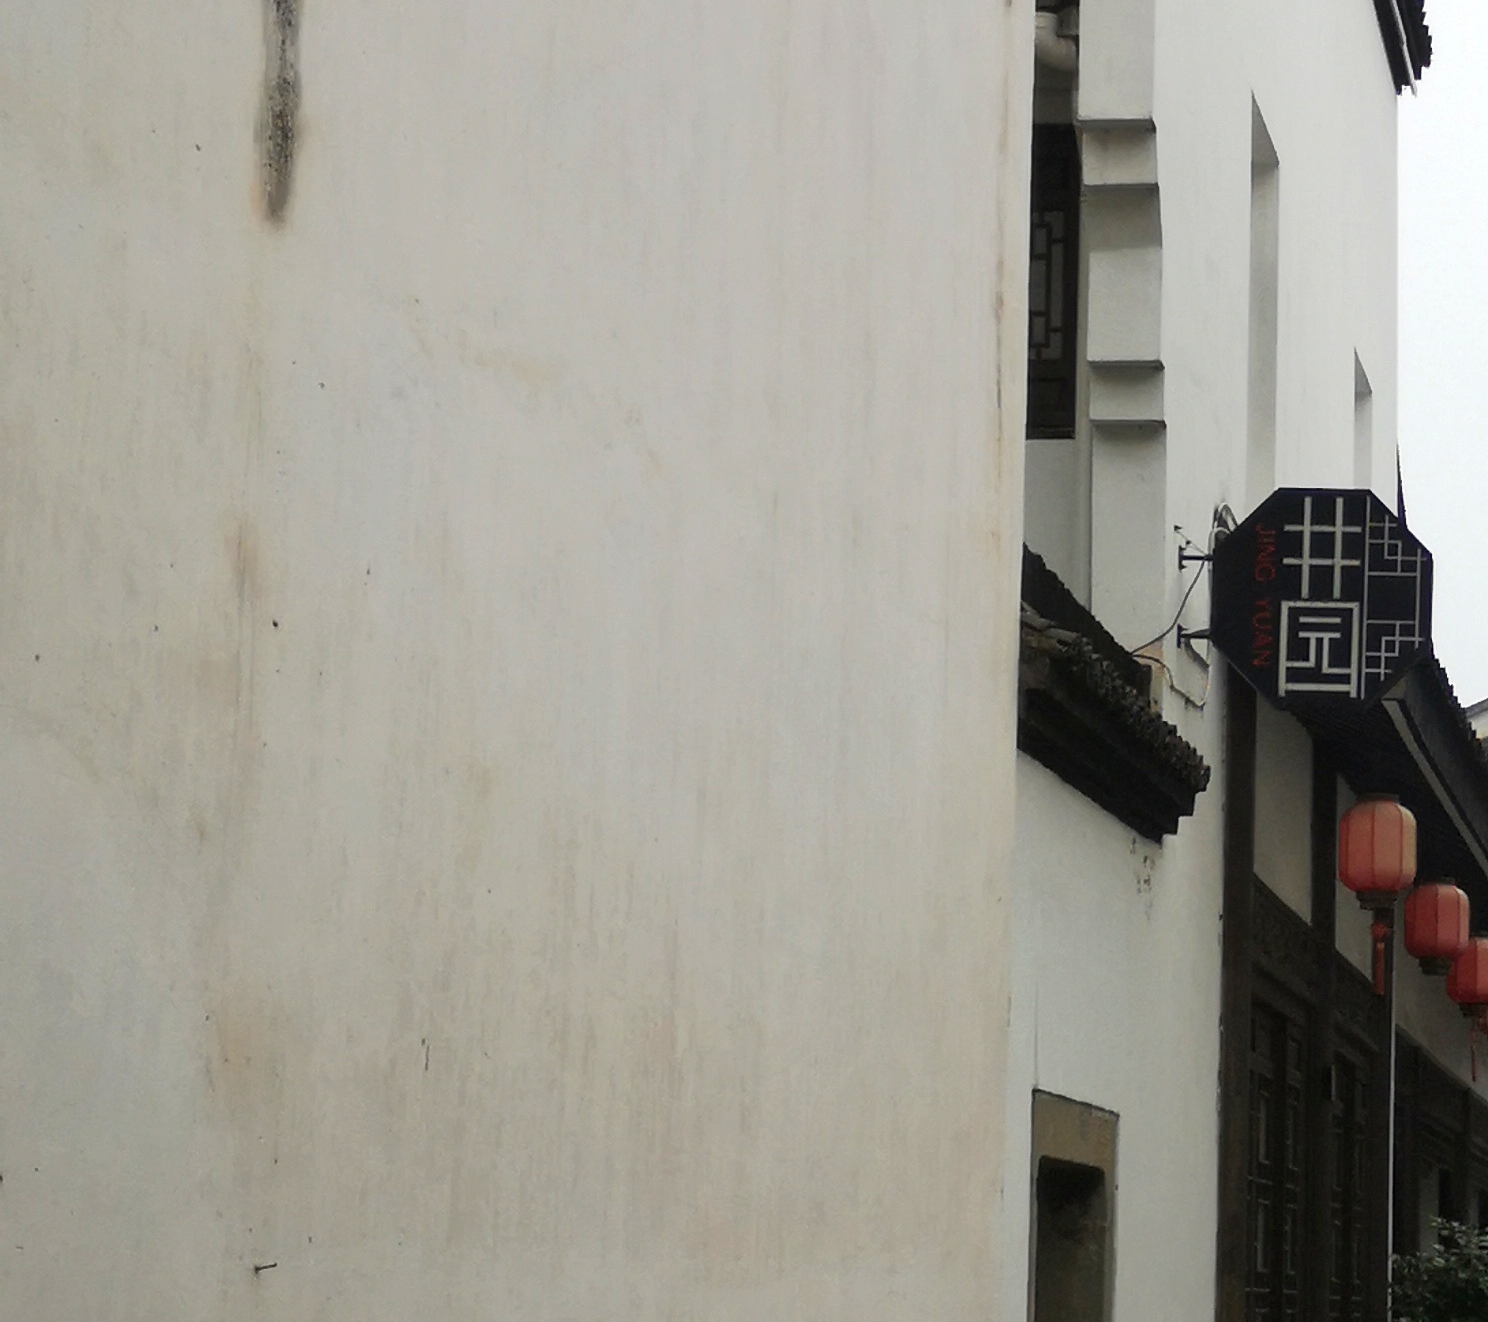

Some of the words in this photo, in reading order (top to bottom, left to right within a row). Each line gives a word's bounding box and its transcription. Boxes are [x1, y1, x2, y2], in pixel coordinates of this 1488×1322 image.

[1254, 524, 1276, 582] JING
[1278, 495, 1362, 698] 井园
[1251, 598, 1275, 667] YUAN
